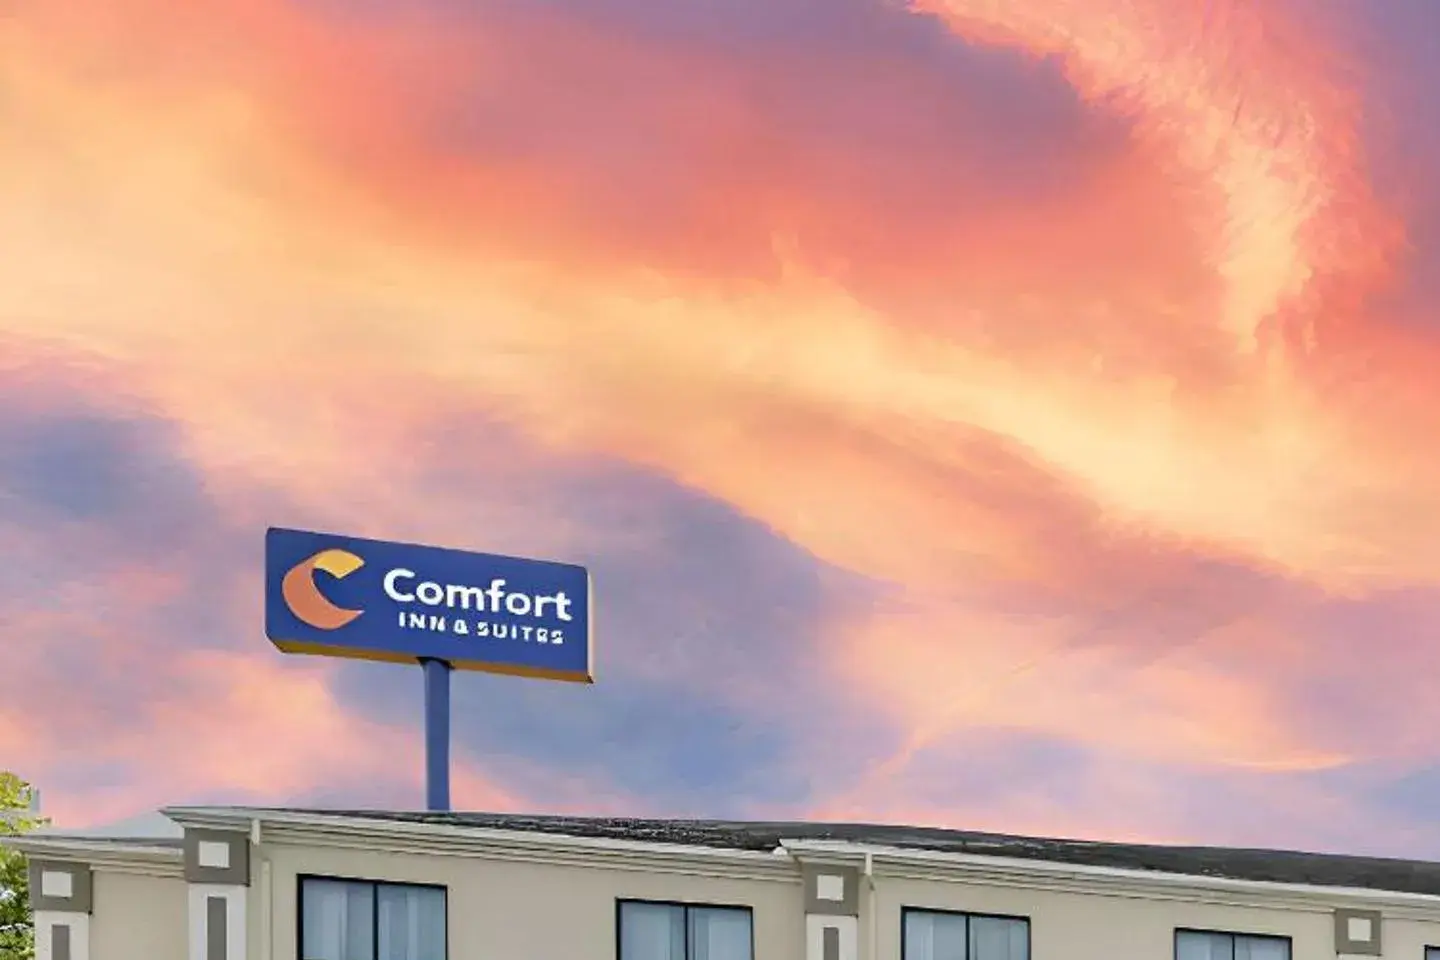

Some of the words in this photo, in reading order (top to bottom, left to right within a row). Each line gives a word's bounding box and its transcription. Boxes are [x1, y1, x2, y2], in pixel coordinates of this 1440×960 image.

[383, 568, 572, 621] Comfort
[399, 612, 446, 632] INN
[453, 619, 468, 635] &
[477, 621, 565, 645] SUITES
